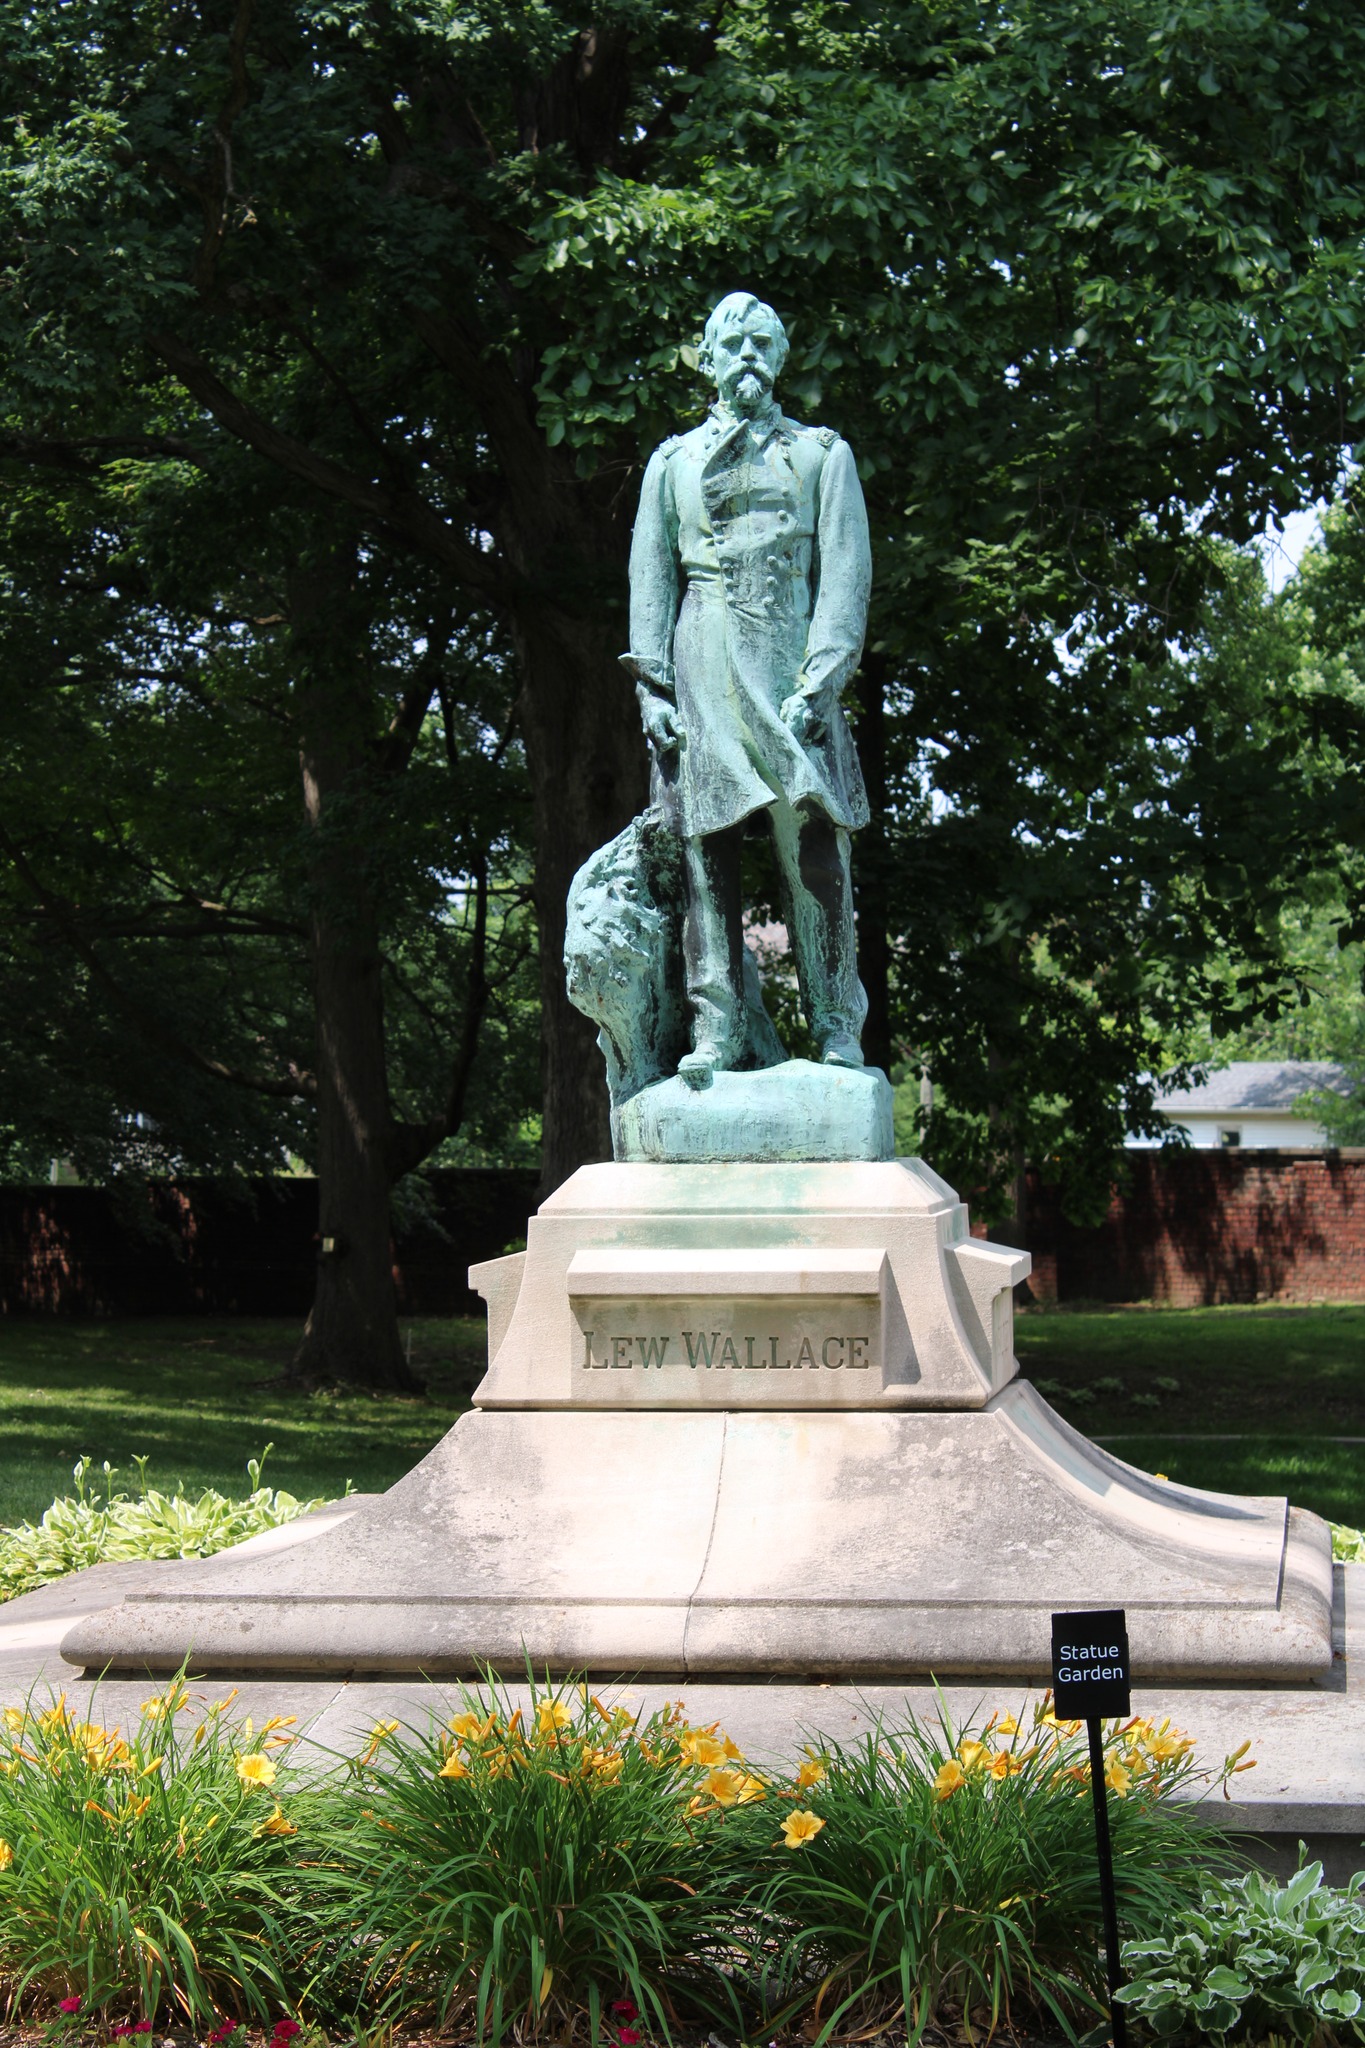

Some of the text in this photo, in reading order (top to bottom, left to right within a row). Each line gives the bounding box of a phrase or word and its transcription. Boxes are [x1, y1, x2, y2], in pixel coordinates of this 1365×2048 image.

[583, 1331, 869, 1369] LEW WALLACE
[1060, 1645, 1119, 1660] Statue
[1058, 1665, 1123, 1682] Garden
